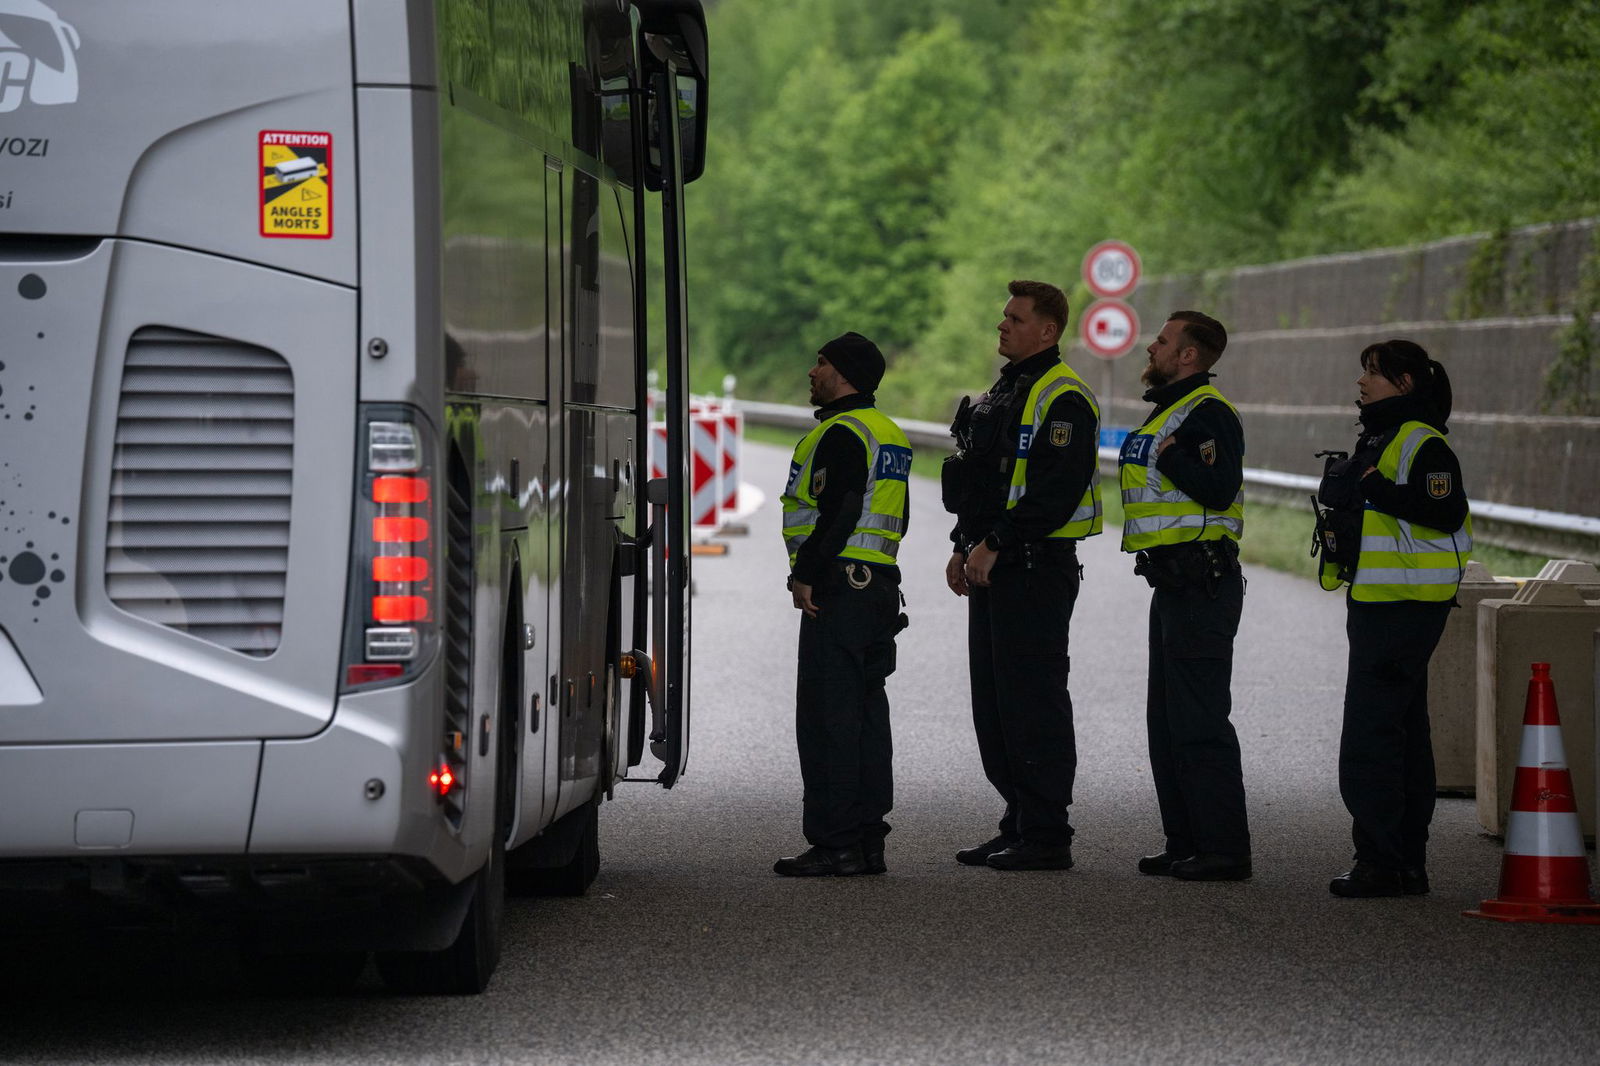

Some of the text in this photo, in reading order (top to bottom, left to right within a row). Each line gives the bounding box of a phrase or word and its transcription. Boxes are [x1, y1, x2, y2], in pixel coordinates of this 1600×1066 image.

[263, 133, 329, 145] ATTENTION
[271, 206, 322, 217] ANGLES
[273, 218, 320, 229] MORTS
